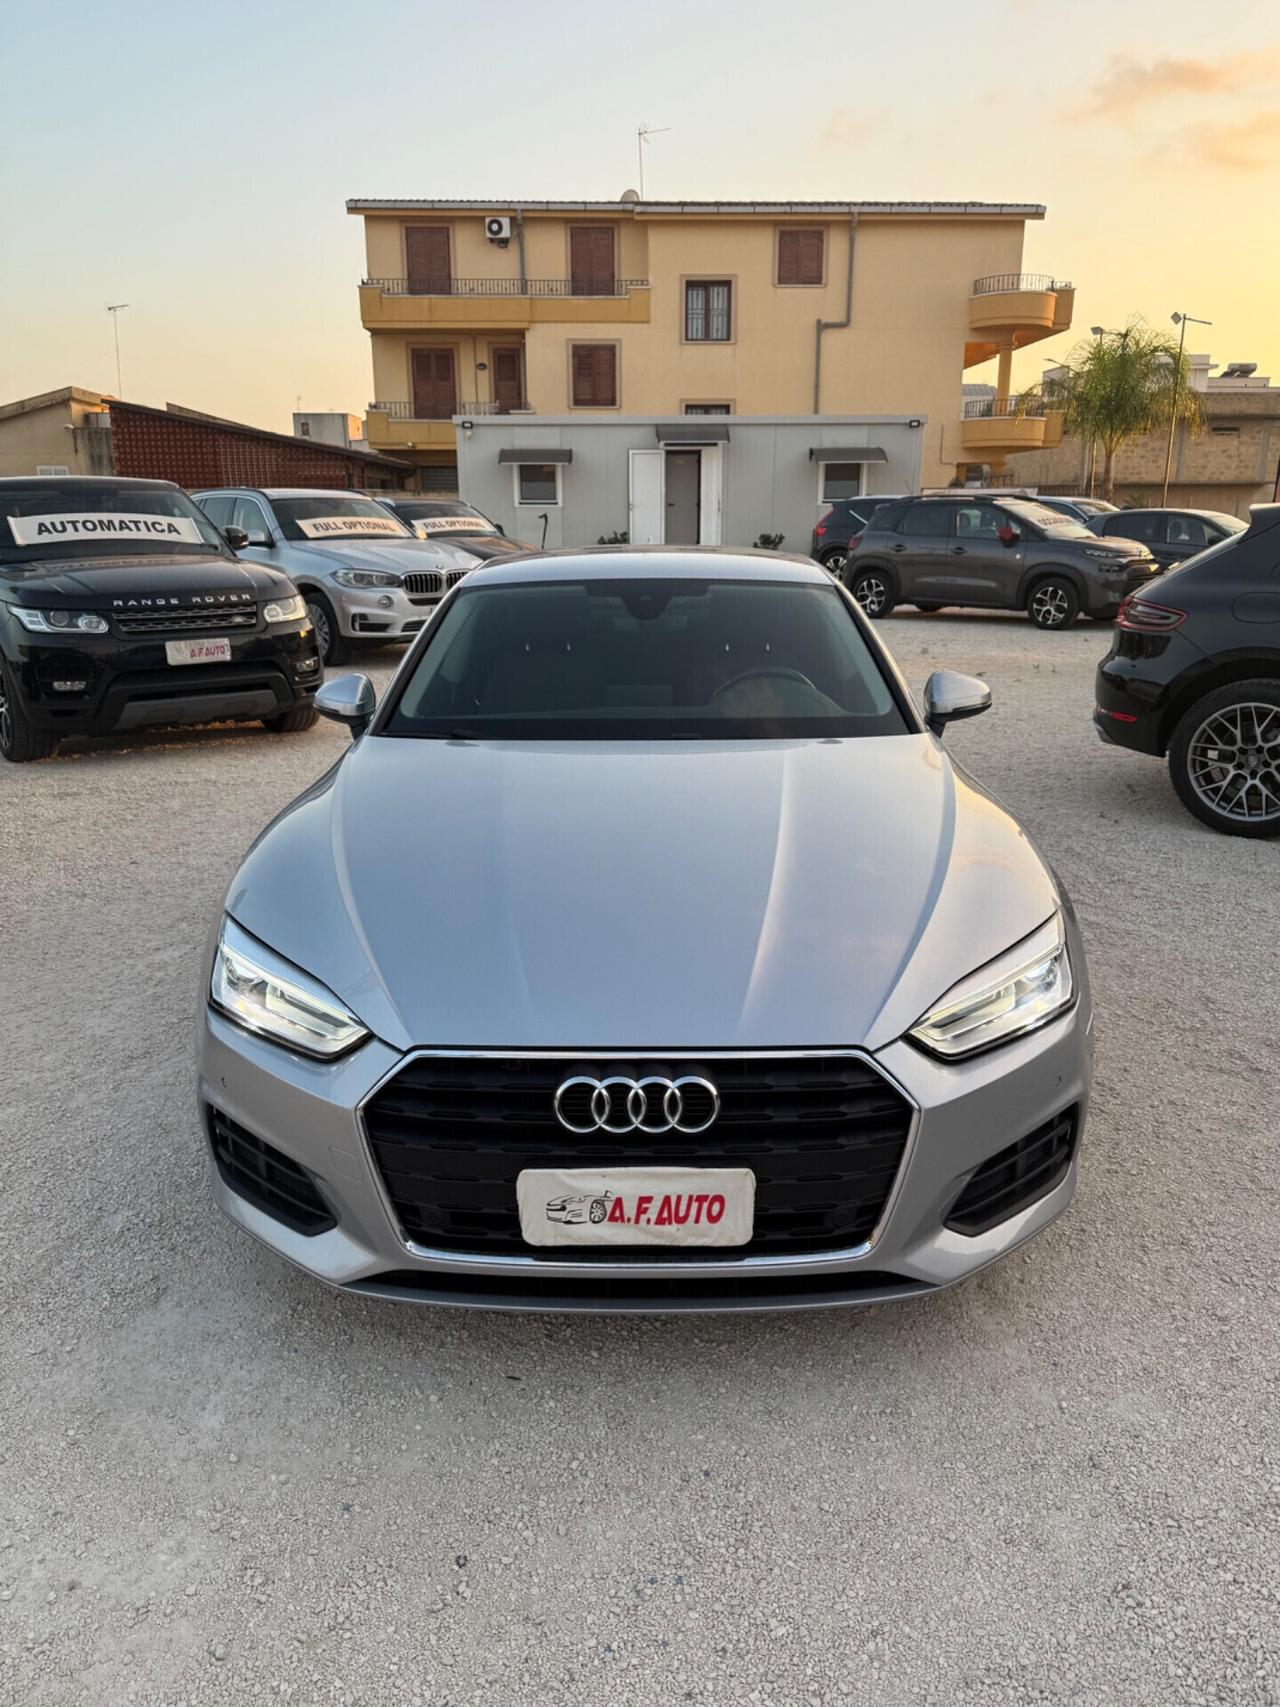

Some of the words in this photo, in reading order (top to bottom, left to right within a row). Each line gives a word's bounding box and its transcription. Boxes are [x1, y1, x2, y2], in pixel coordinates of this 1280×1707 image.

[37, 519, 182, 536] AUTOMATICA
[312, 521, 343, 533] FULL
[343, 520, 396, 532] OPTIONAL
[113, 598, 180, 607] RANGE
[192, 594, 251, 603] ROVER
